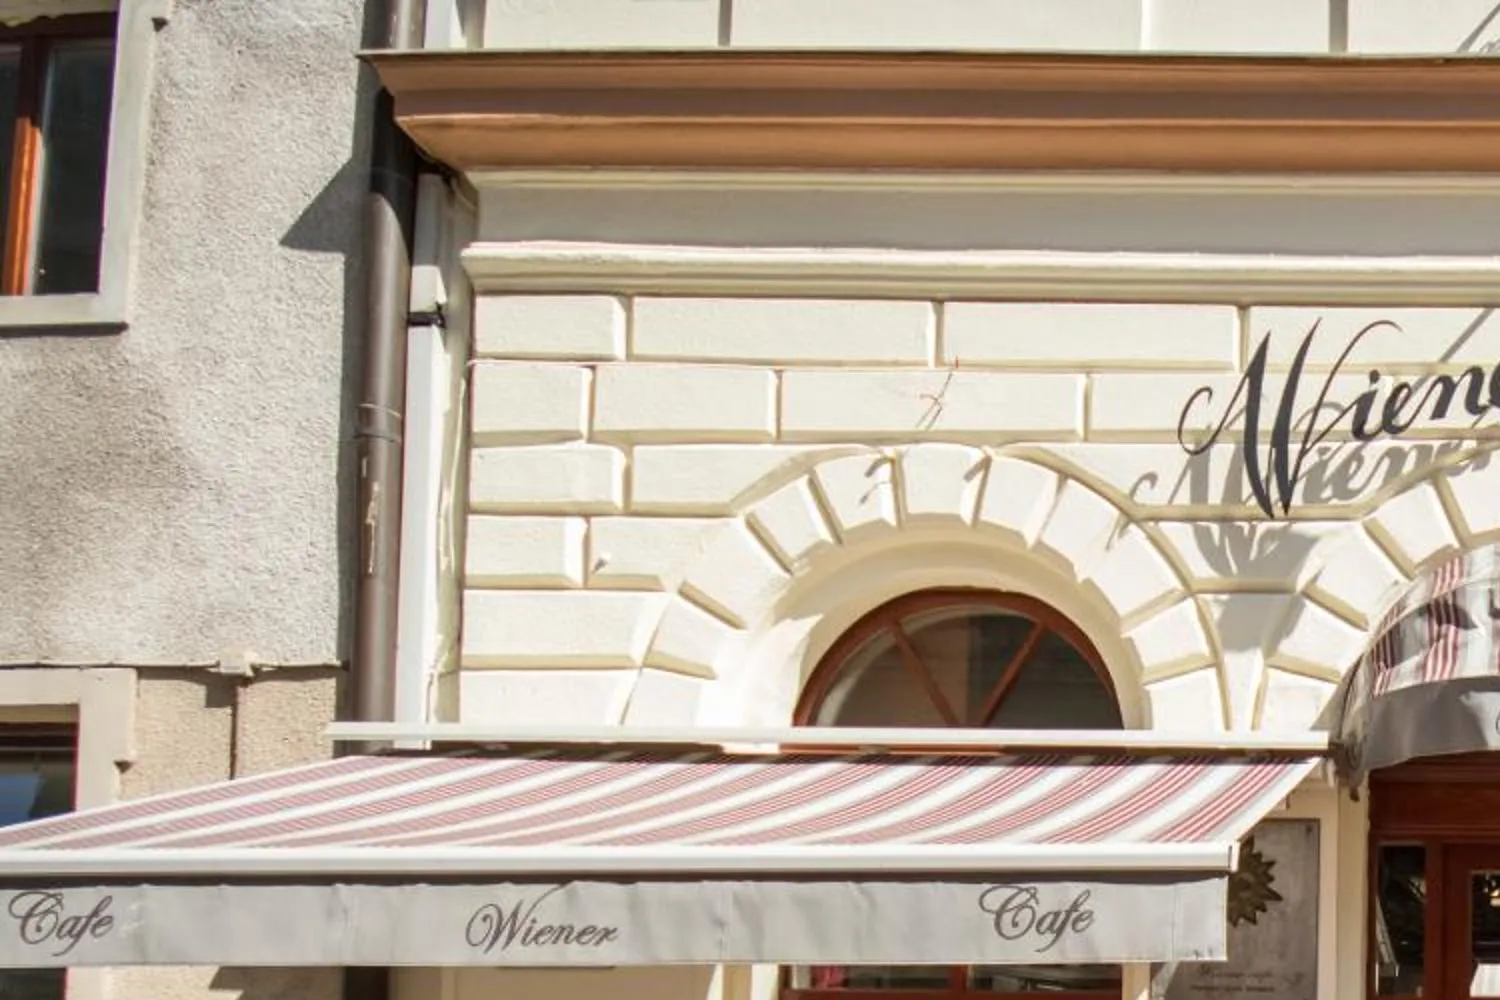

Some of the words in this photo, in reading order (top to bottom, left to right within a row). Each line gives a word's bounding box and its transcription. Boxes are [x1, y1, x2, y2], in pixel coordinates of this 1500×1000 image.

[8, 891, 113, 956] Cafe
[465, 883, 618, 952] Wiener
[979, 884, 1094, 953] Cafe
